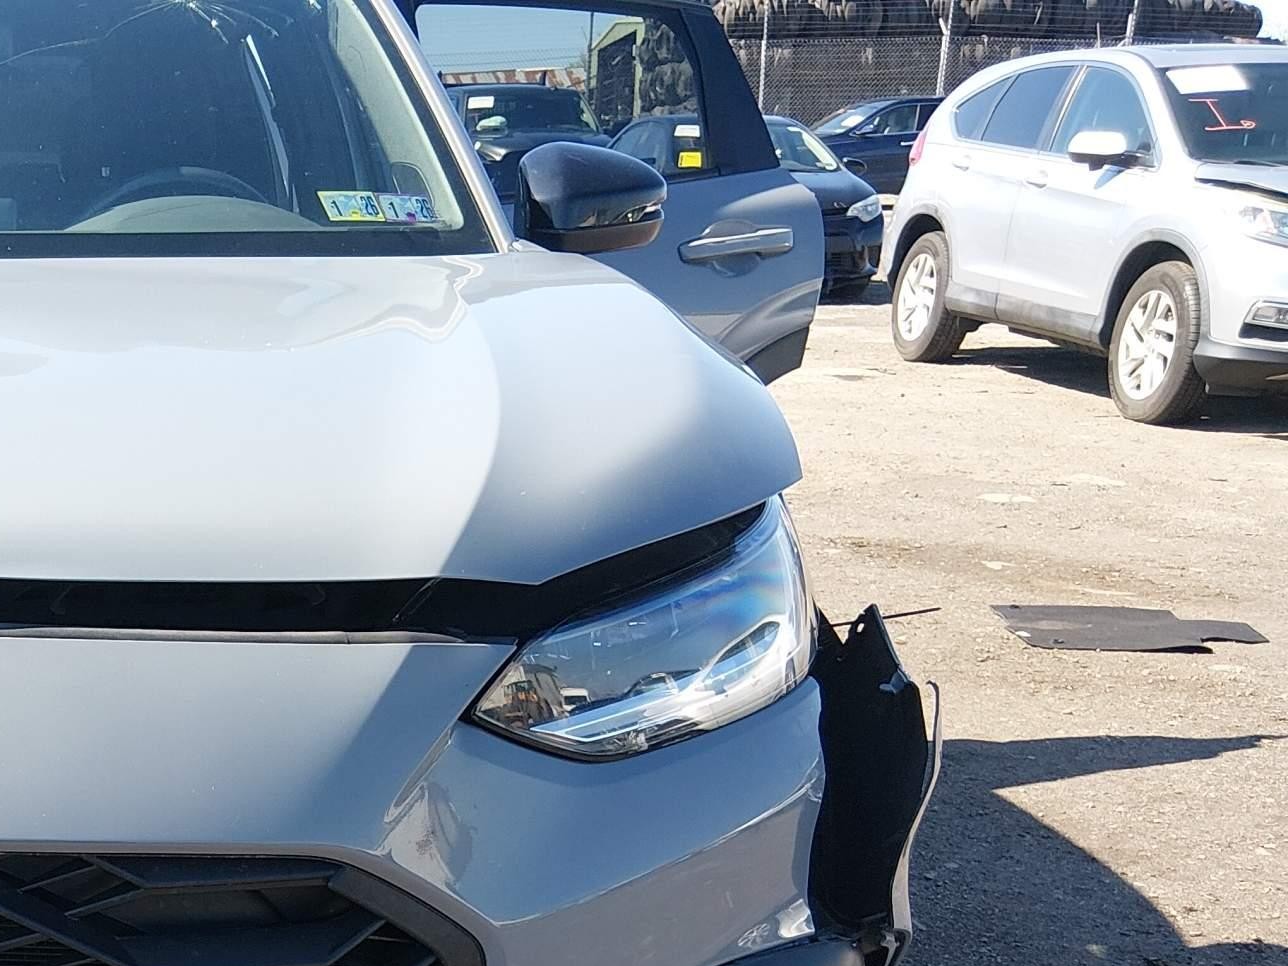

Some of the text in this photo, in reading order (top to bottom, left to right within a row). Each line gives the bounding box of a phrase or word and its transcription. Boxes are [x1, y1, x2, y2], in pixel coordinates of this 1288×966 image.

[331, 196, 379, 216] 1 26
[388, 201, 399, 218] 1
